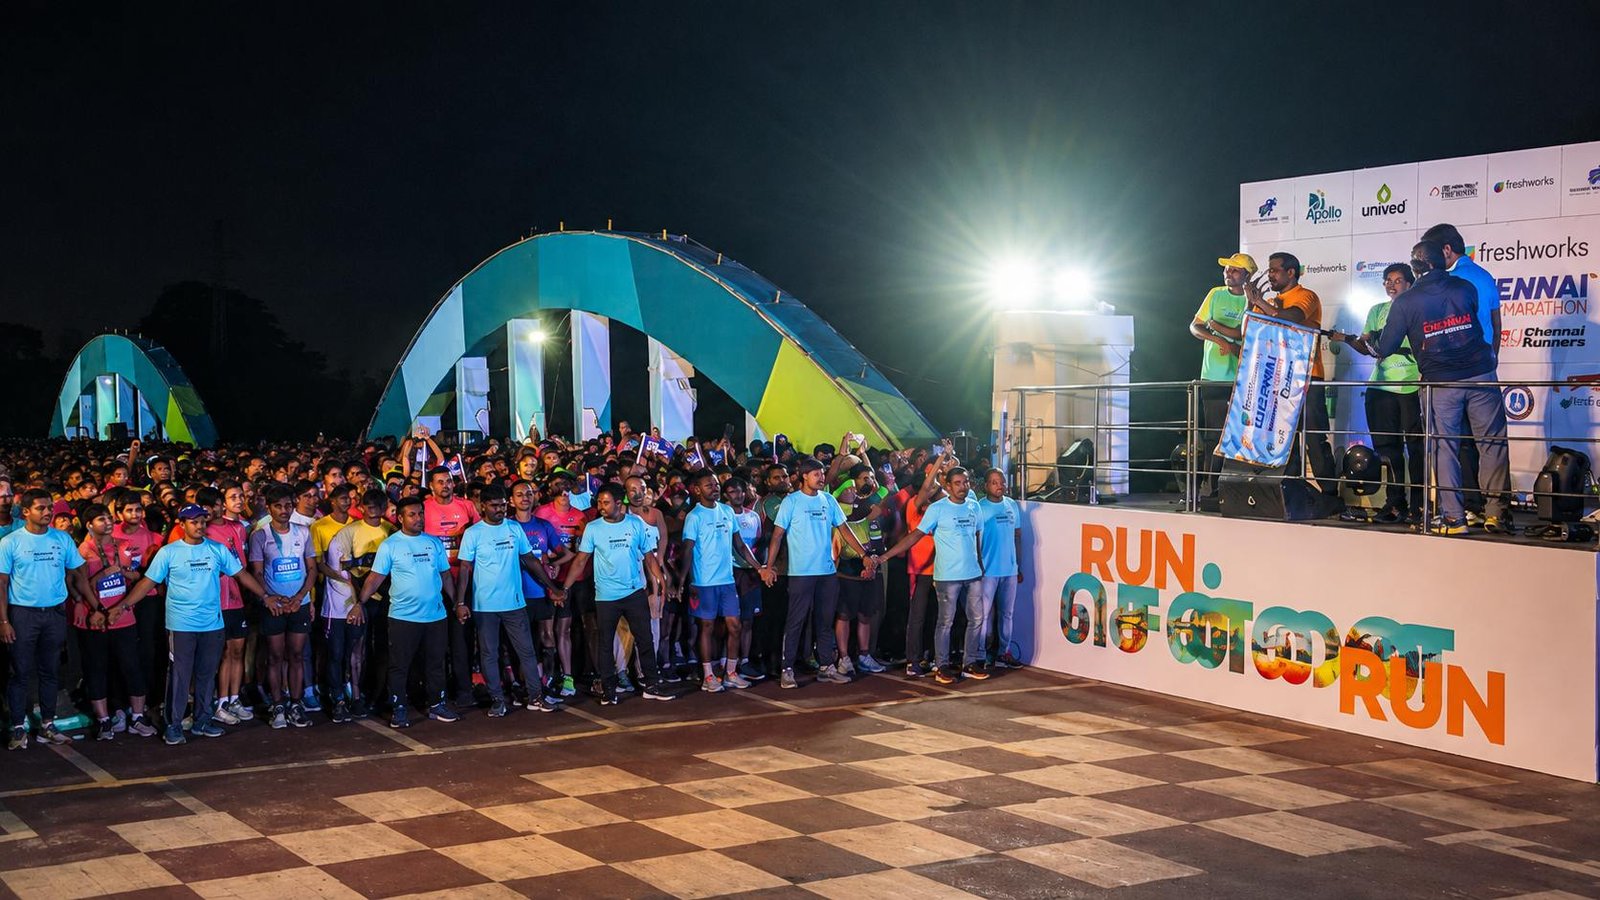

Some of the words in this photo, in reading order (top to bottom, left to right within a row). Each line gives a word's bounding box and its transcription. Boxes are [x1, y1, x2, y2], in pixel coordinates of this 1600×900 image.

[1505, 176, 1555, 190] freshworks
[1306, 205, 1342, 224] Apollo
[1361, 200, 1406, 217] unived
[1479, 236, 1589, 262] freshworks
[1306, 263, 1347, 274] freshworks
[1496, 273, 1588, 301] ENNAI
[1503, 300, 1587, 316] MARATHON
[1524, 325, 1585, 337] Chennai
[1522, 337, 1585, 348] Runners
[1081, 523, 1196, 592] RUN
[1339, 646, 1505, 746] RUN
